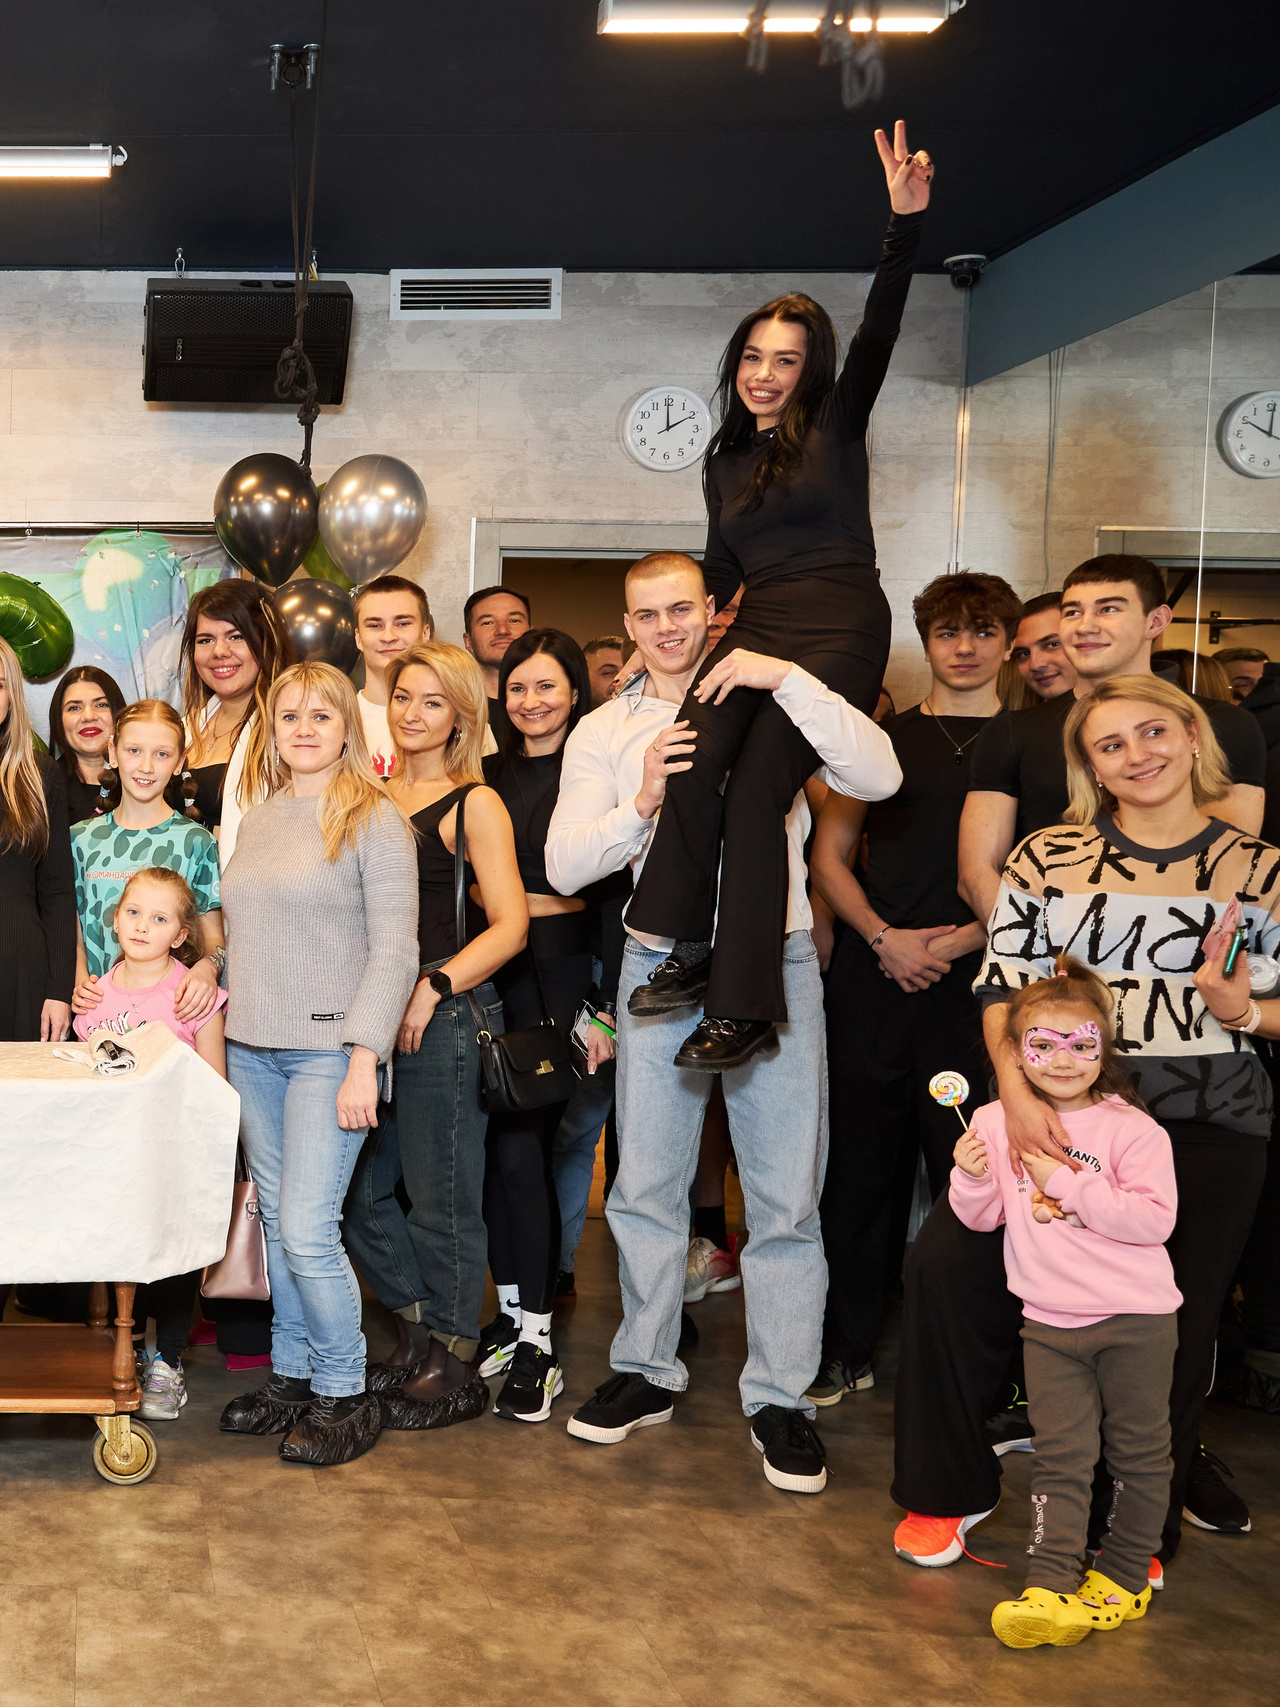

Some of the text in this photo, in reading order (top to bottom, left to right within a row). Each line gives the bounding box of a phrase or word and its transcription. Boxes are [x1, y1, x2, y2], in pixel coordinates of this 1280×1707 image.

[651, 402, 659, 411] 11
[664, 398, 674, 407] 12
[681, 402, 686, 411] 1
[640, 411, 651, 420] 10
[688, 410, 696, 420] 2
[636, 424, 643, 433] 9
[692, 424, 699, 433] 3
[639, 438, 647, 447] 8
[688, 438, 694, 447] 4
[649, 448, 656, 457] 7
[662, 451, 670, 461] 6
[677, 448, 684, 457] 5
